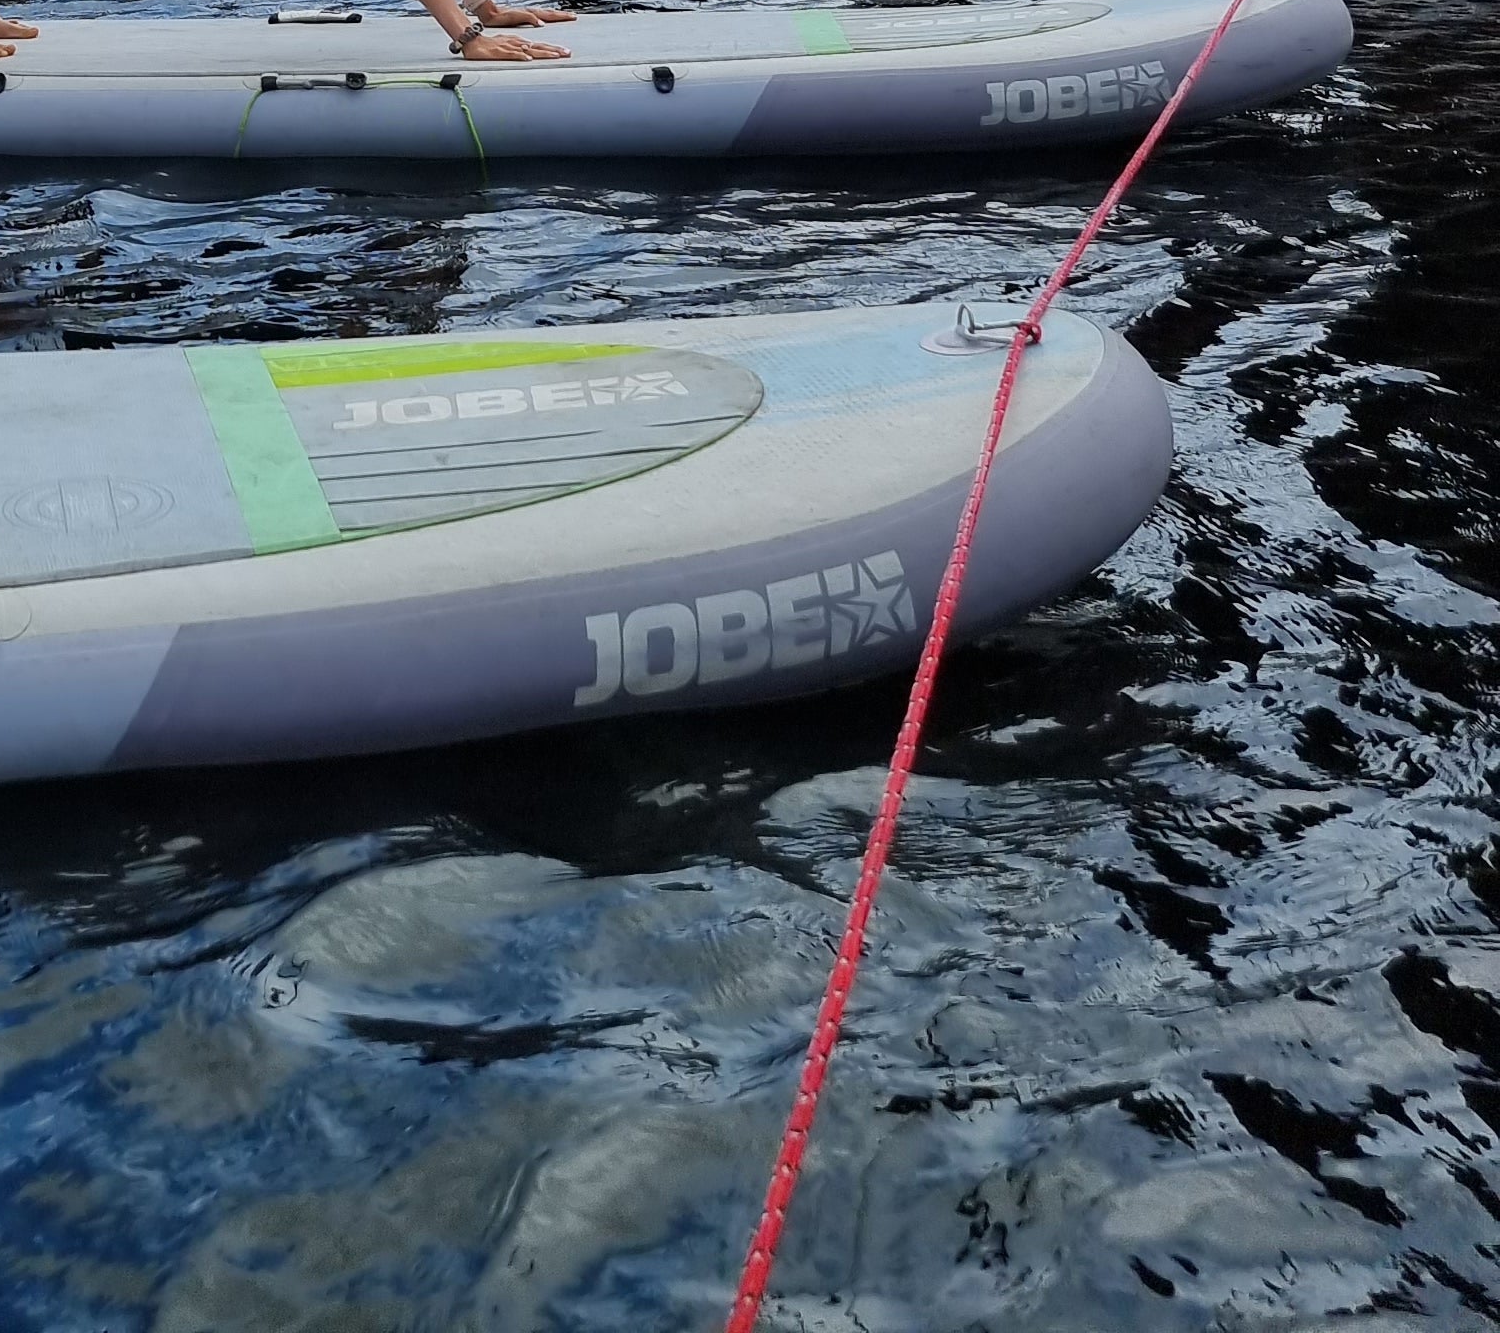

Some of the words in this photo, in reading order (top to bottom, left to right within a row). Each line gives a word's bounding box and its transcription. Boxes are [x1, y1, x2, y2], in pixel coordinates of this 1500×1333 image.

[980, 68, 1121, 126] JOBE
[333, 379, 588, 430] JOBE
[573, 571, 827, 707] JOBE
